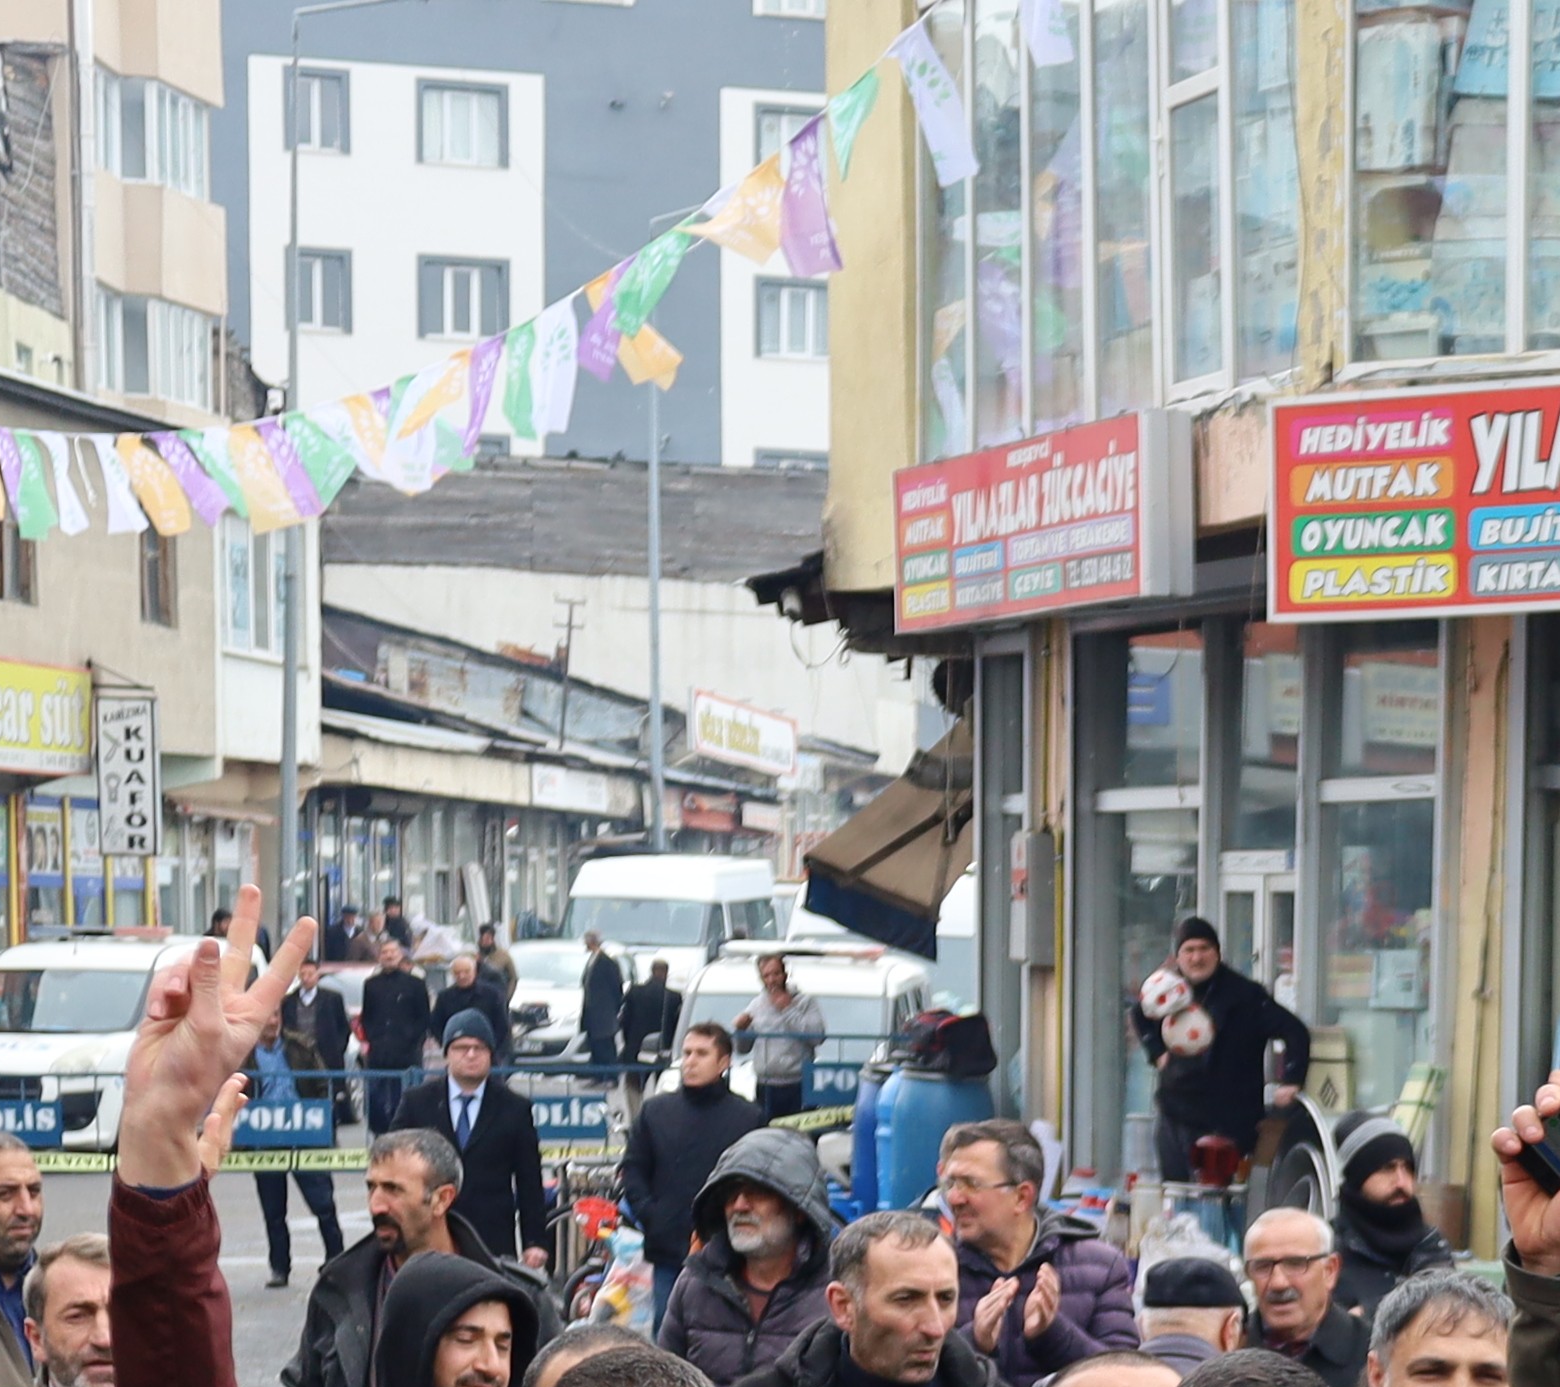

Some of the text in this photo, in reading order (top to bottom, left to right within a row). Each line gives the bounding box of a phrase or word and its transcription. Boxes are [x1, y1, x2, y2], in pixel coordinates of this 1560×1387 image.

[1299, 412, 1452, 455] HEDİYELİK
[952, 437, 1136, 546] YILMAZLAR ZÜCCACİYE
[1305, 461, 1441, 503] MUTFAK
[1300, 512, 1448, 553] OYUNCAK
[904, 551, 949, 583] OYUNCAK
[1303, 553, 1449, 598] PLASTİK
[533, 1099, 605, 1128] OLİS
